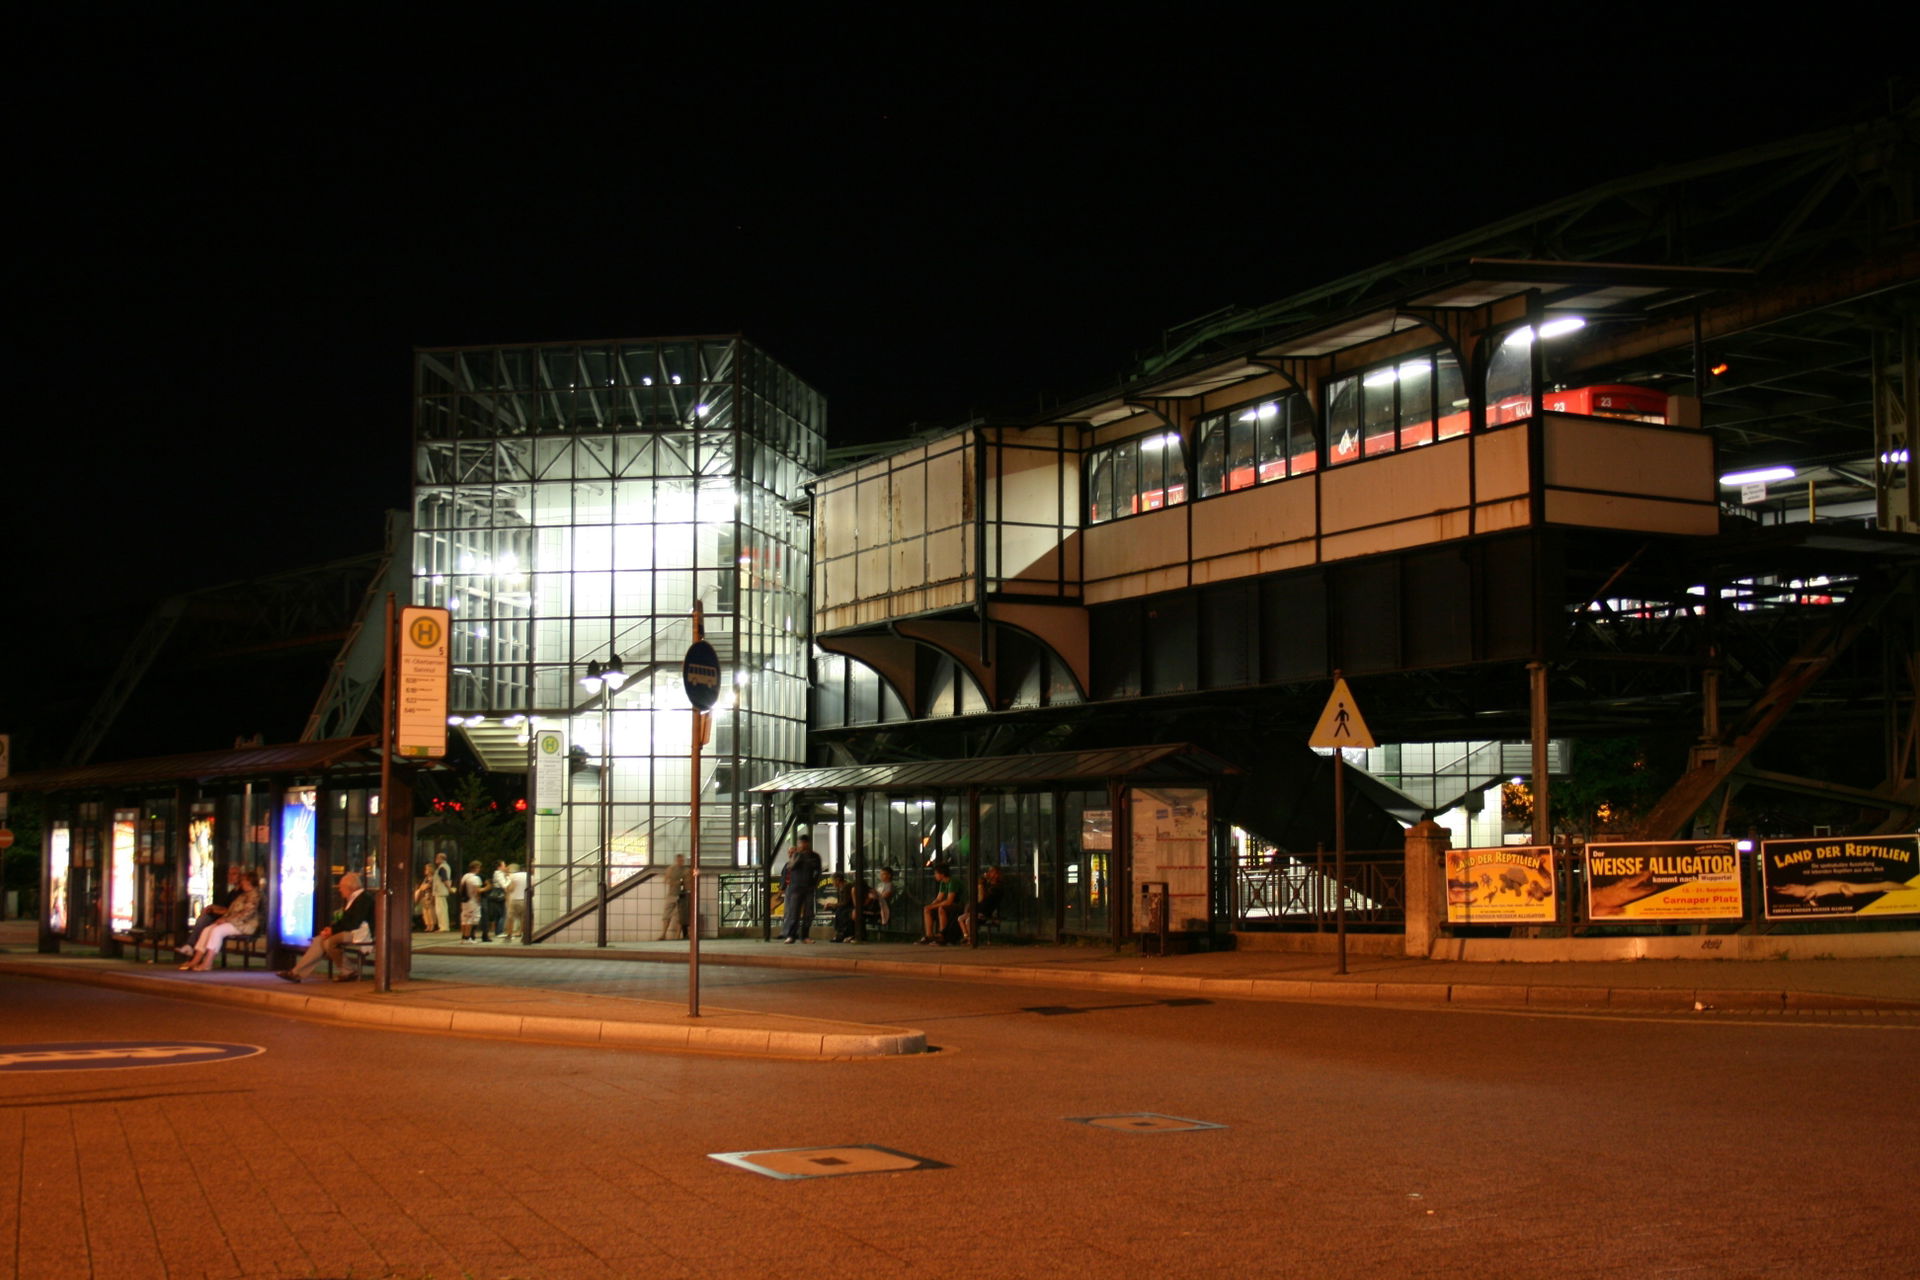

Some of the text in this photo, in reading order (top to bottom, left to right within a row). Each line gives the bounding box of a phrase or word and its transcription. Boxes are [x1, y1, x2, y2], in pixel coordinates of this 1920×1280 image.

[1554, 402, 1565, 412] 23
[1601, 397, 1612, 407] 23
[418, 623, 433, 642] H
[1479, 854, 1493, 864] DER
[1495, 851, 1540, 869] REPTILIEN
[1774, 843, 1910, 868] LAND DER REPTILIEN
[1591, 855, 1734, 876] WEISSE ALLIGATOR
[1652, 874, 1732, 883] kommt nach Wuppertal
[1663, 895, 1738, 905] Carnaper Platz
